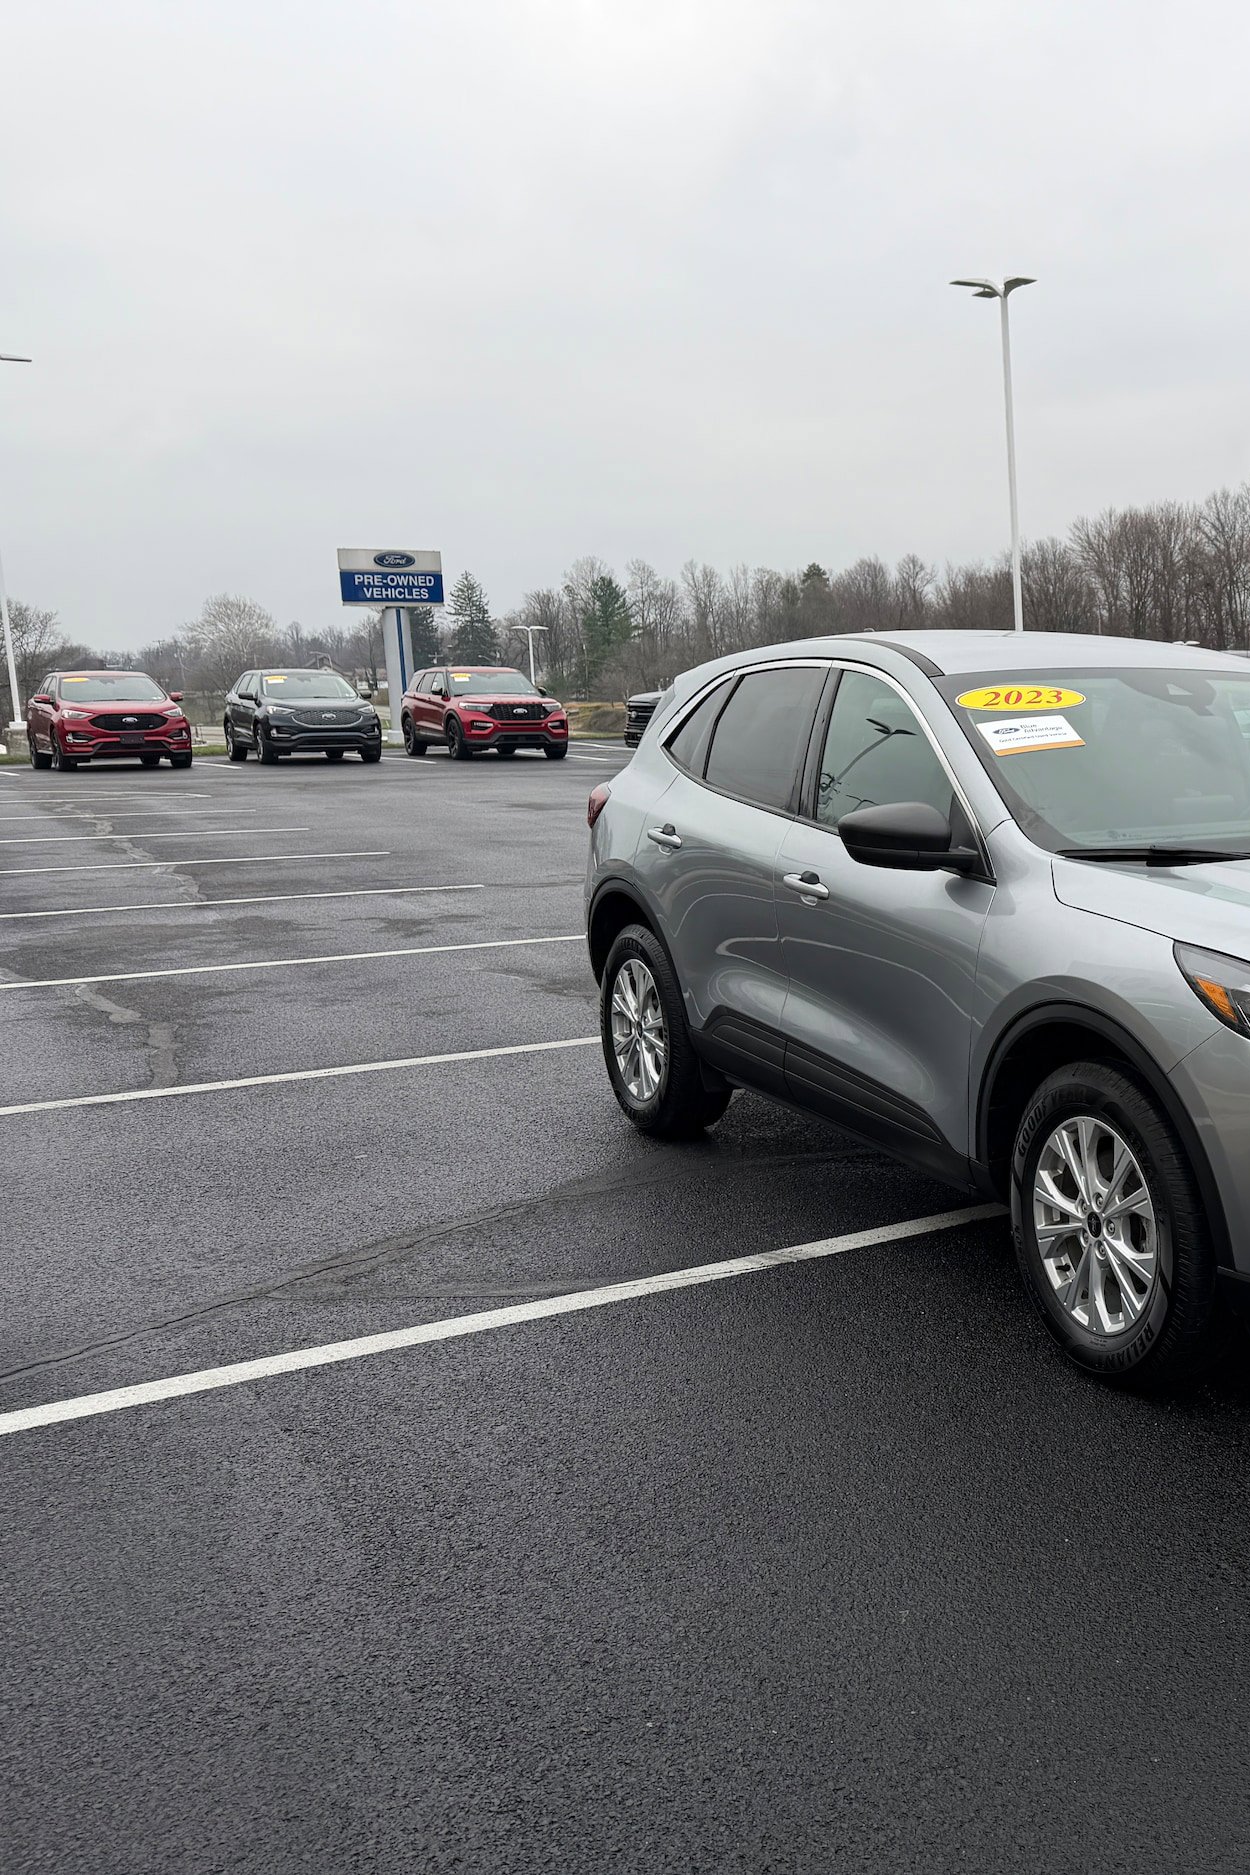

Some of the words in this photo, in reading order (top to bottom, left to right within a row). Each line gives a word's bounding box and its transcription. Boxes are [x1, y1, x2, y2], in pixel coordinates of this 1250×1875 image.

[383, 555, 407, 565] Ford
[354, 574, 435, 587] PRE-OWNED
[363, 587, 429, 599] VEHICLES
[983, 690, 1063, 707] 2023
